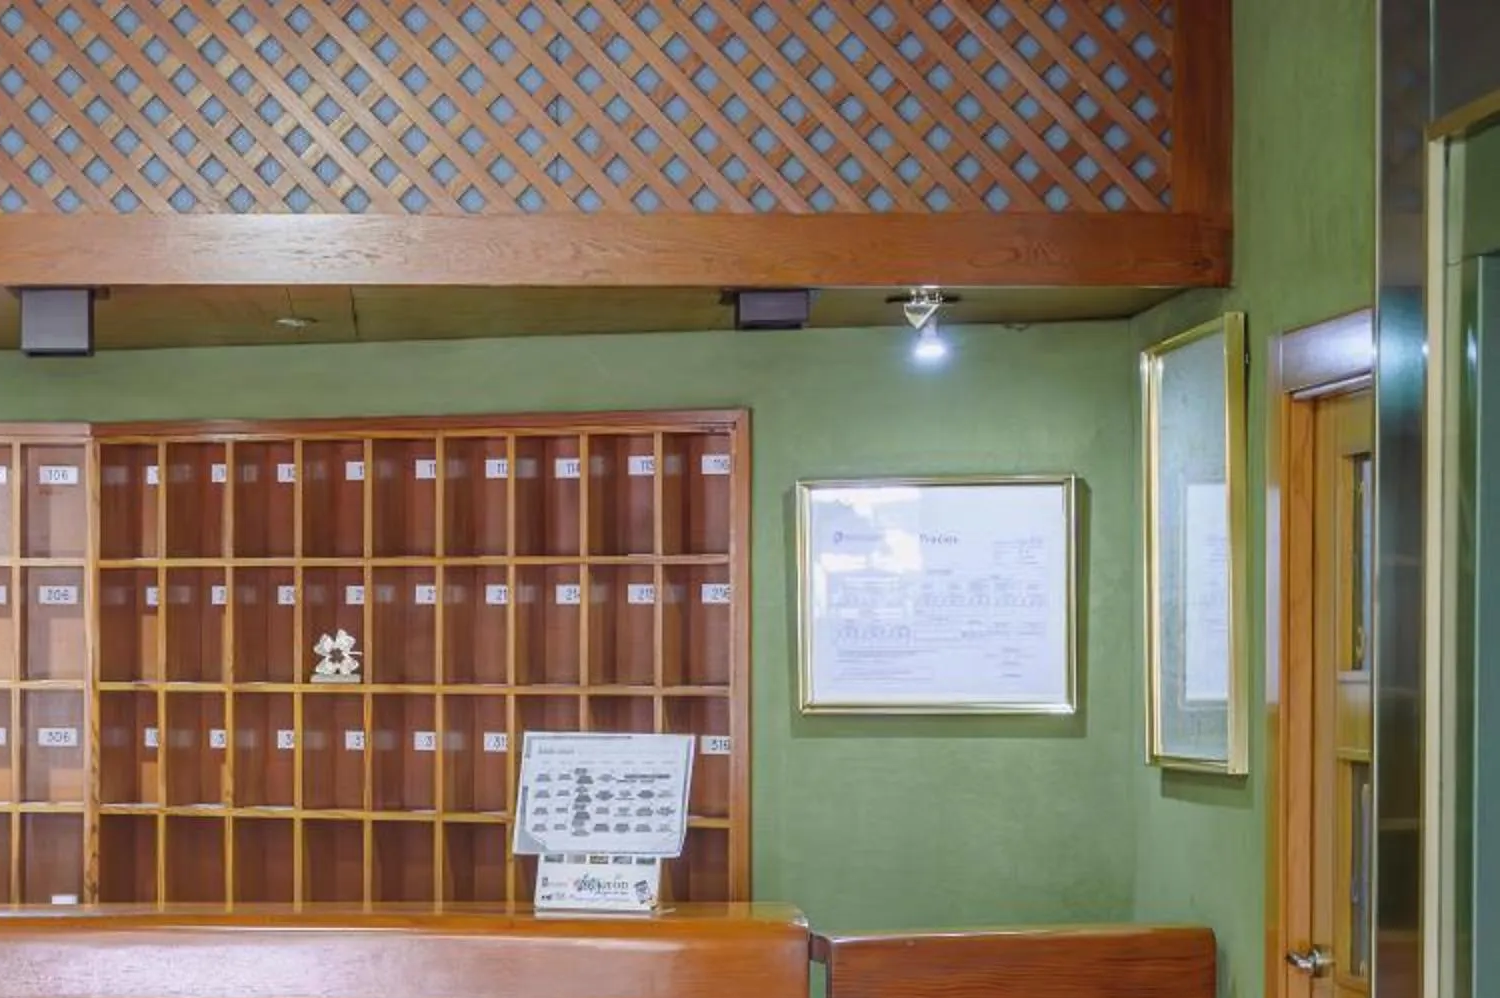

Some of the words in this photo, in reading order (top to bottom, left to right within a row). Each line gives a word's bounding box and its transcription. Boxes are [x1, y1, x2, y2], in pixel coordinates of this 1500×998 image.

[47, 469, 69, 481] 106
[47, 589, 69, 601] 206
[47, 731, 69, 743] 306
[711, 739, 730, 751] 316
